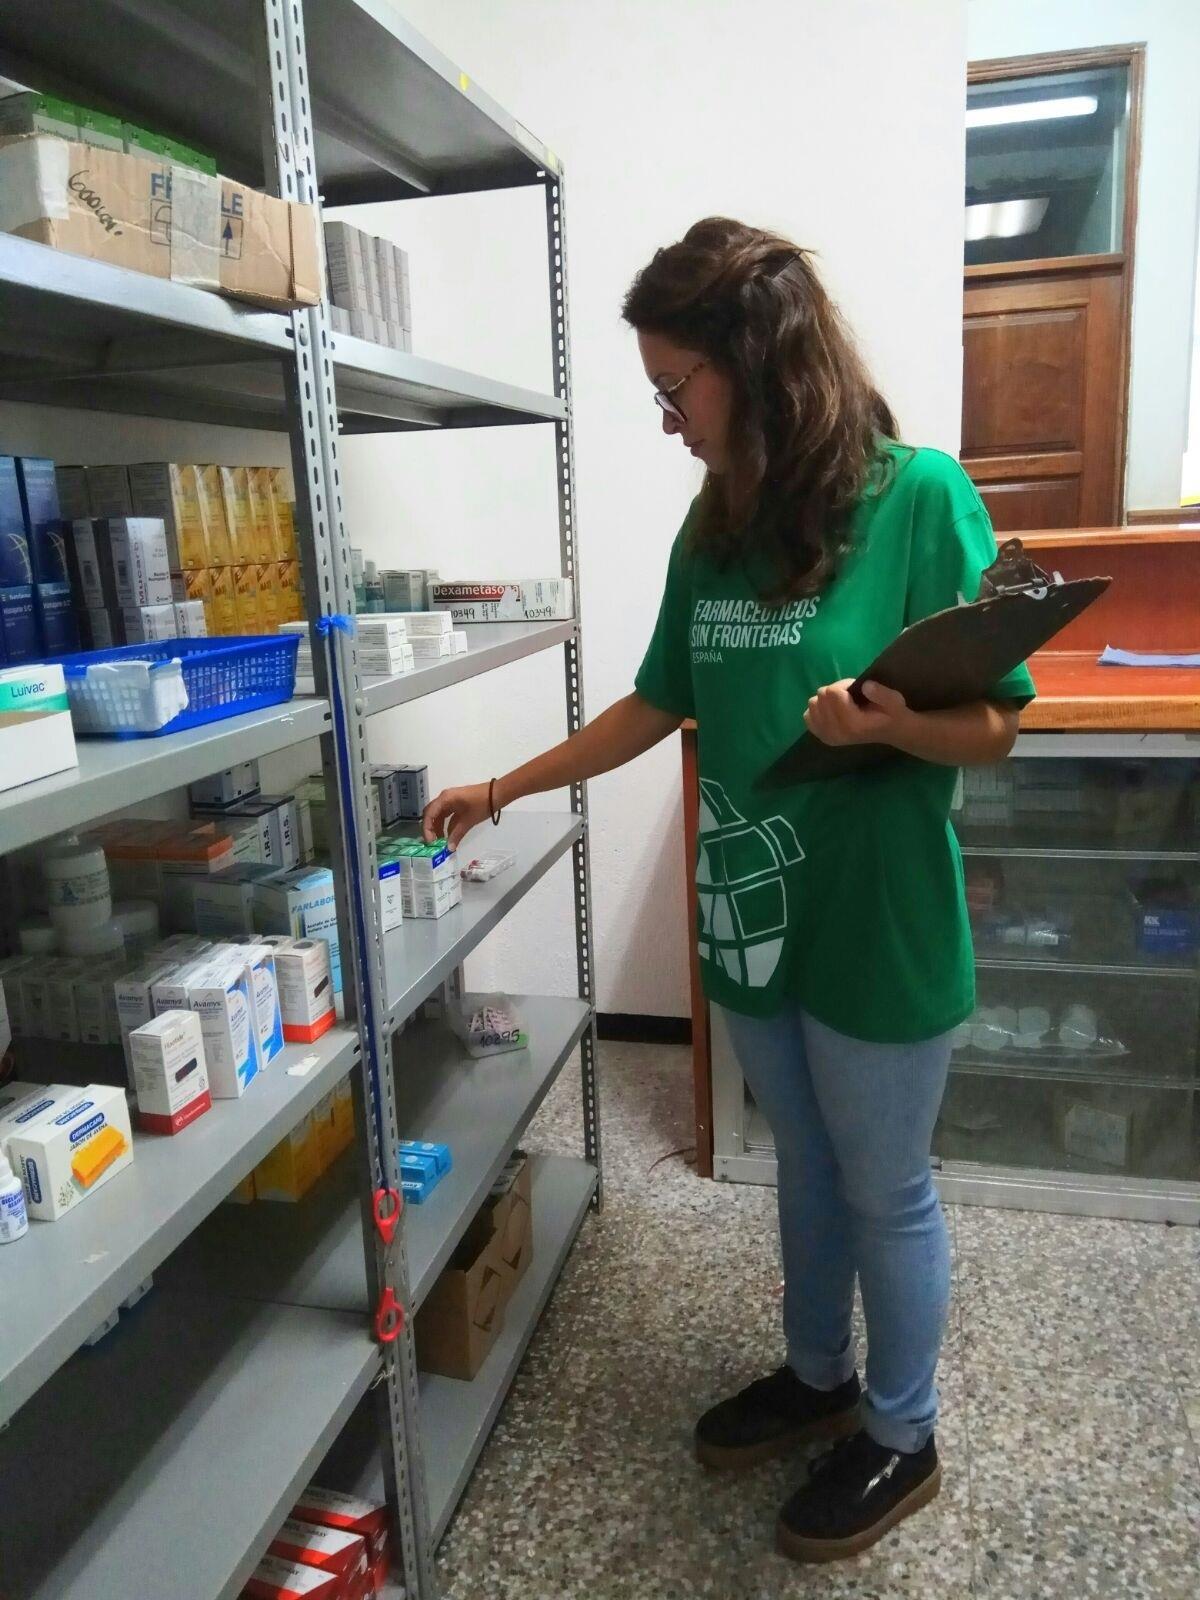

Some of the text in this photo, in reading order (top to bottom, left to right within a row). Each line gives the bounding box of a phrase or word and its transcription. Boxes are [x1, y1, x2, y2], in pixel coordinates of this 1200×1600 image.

[432, 584, 520, 597] Dexametasoa
[690, 621, 803, 648] SIN FRONTERAS
[692, 649, 723, 664] ESPAÑA
[11, 681, 46, 698] Luivac
[193, 1001, 221, 1009] Avamys
